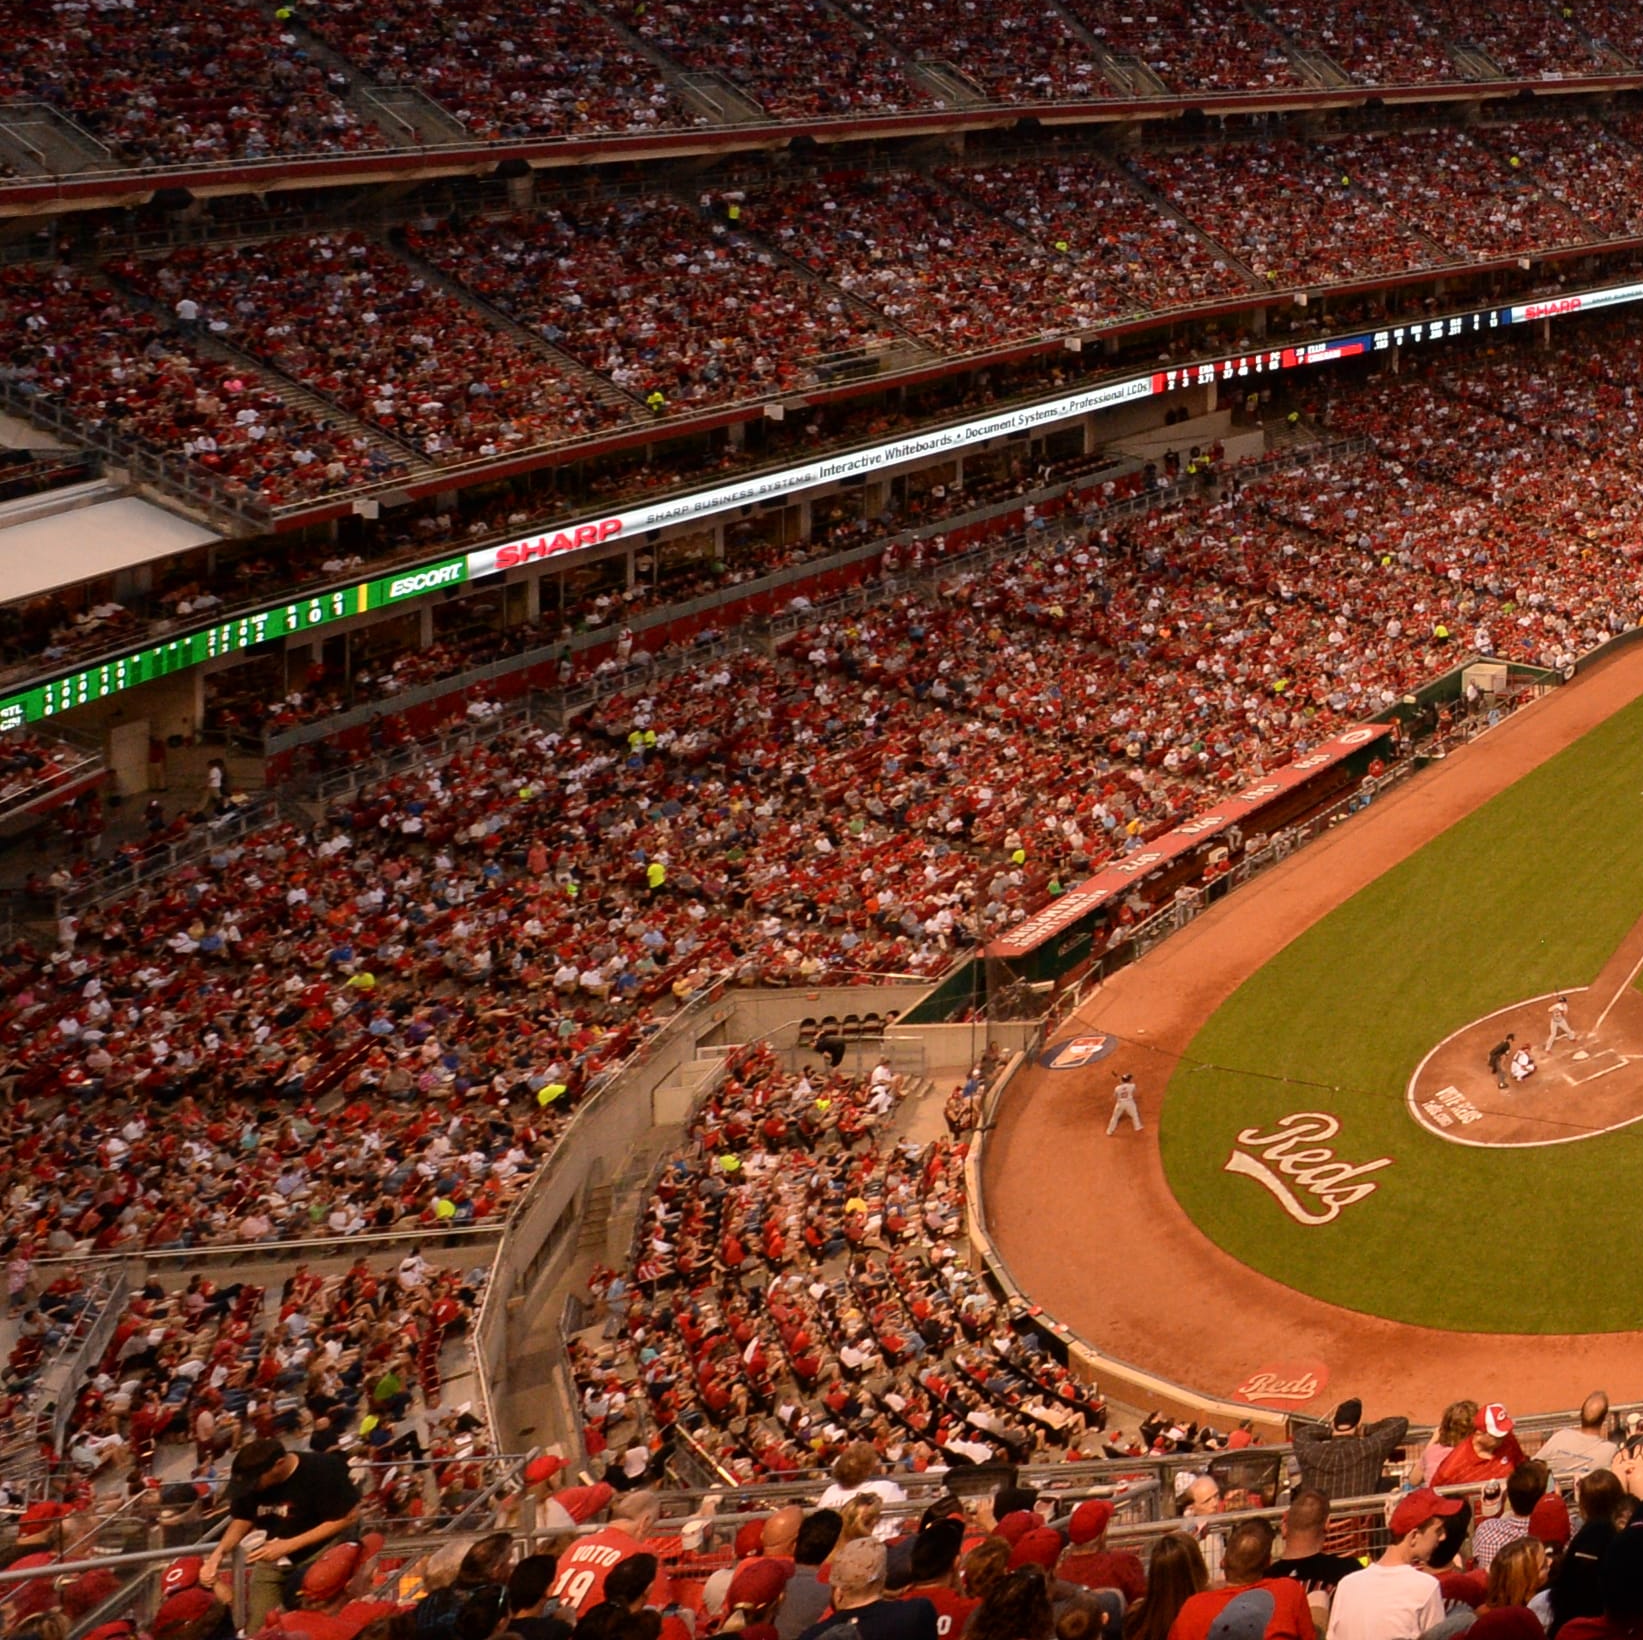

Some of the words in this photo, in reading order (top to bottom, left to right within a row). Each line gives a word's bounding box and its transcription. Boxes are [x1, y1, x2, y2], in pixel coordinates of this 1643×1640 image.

[1524, 298, 1582, 321] SHARP
[645, 504, 689, 525] SHARP
[693, 488, 755, 512] BUSINESS
[759, 472, 812, 496] SYSTEMS
[819, 454, 883, 480] Interactive
[885, 433, 953, 462] Whiteboards
[965, 416, 1016, 440] Document
[1017, 406, 1059, 427] Systems
[1069, 388, 1125, 412] Professional
[1126, 379, 1149, 398] LCDs
[493, 518, 624, 570] SHARP
[389, 562, 464, 599] ESCORT
[309, 608, 322, 623] 0
[1001, 892, 1088, 945] CHAMPIONS
[1225, 1112, 1394, 1225] Reds
[1238, 1371, 1319, 1402] Reds
[570, 1544, 621, 1568] VOTTO
[552, 1567, 595, 1610] 19
